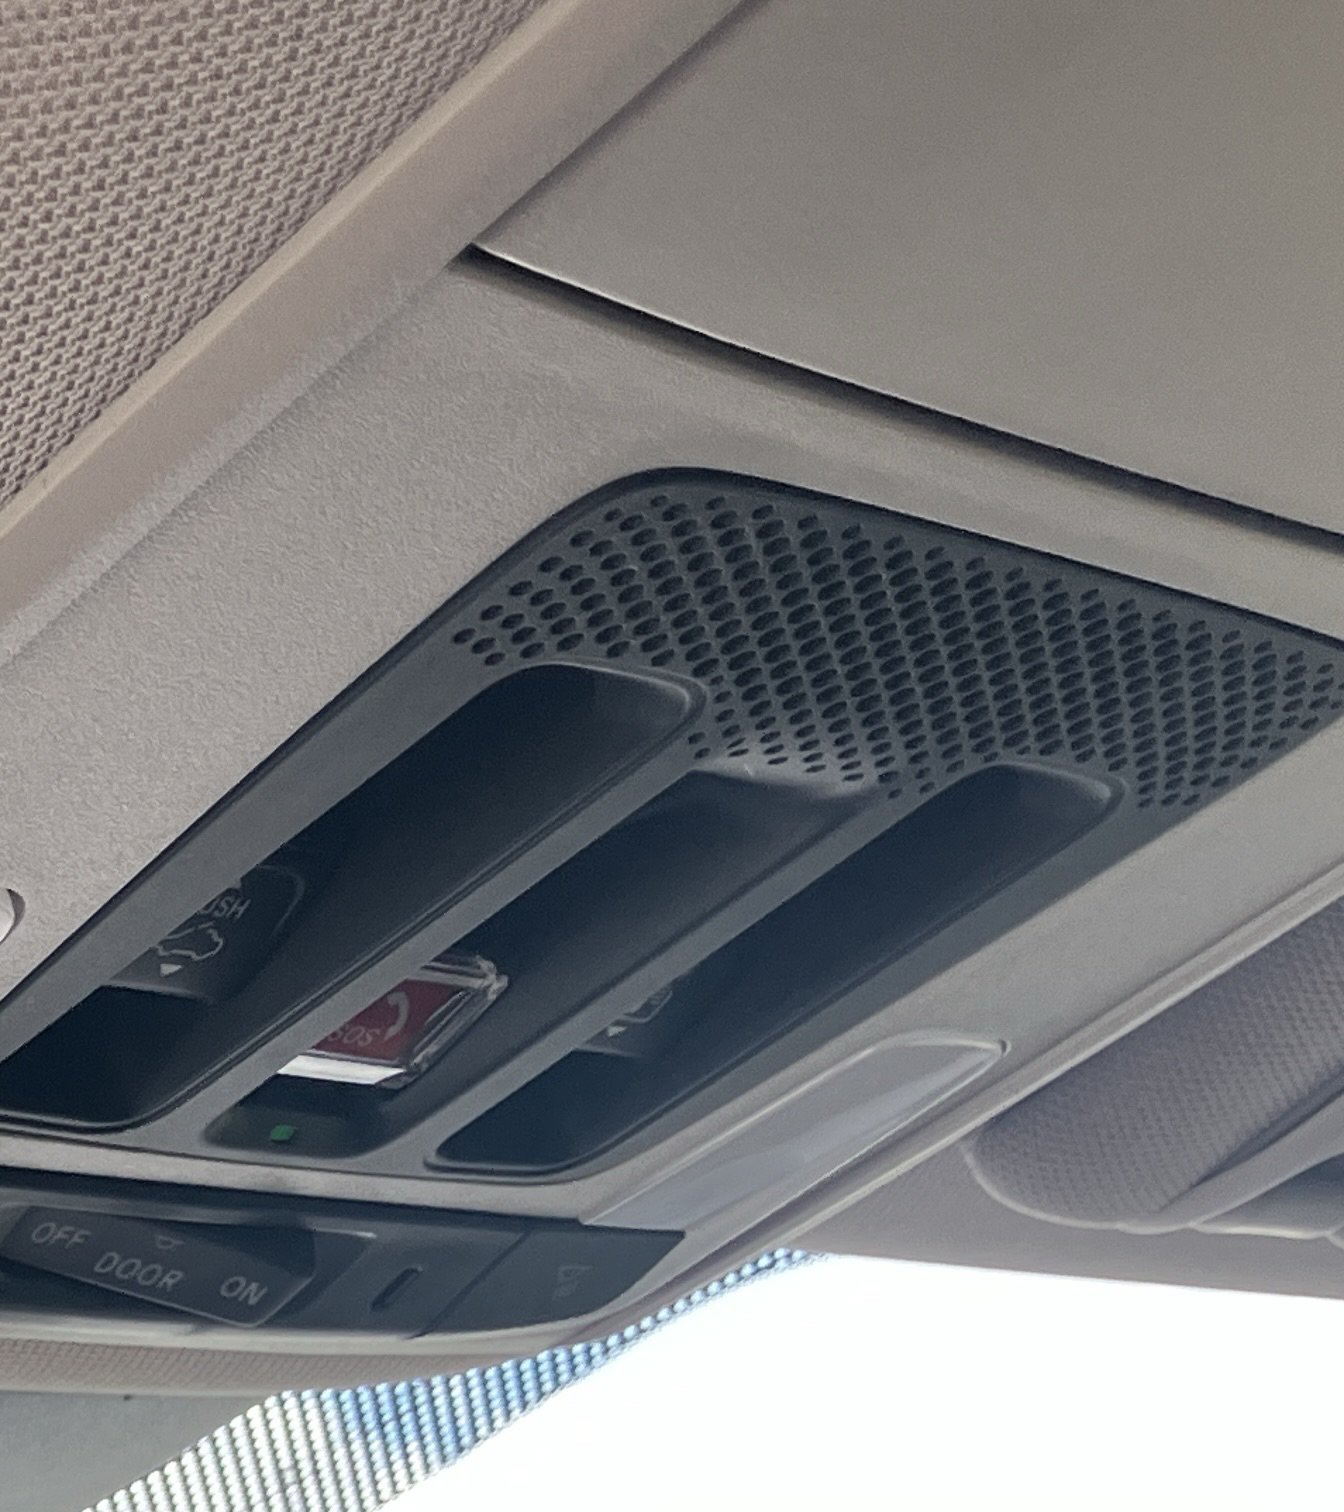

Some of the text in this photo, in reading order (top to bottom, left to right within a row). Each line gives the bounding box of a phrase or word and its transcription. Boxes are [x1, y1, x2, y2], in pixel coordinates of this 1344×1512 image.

[198, 895, 253, 920] USH
[30, 1221, 93, 1250] OFF
[93, 1251, 185, 1292] DOOR
[219, 1275, 269, 1307] ON
